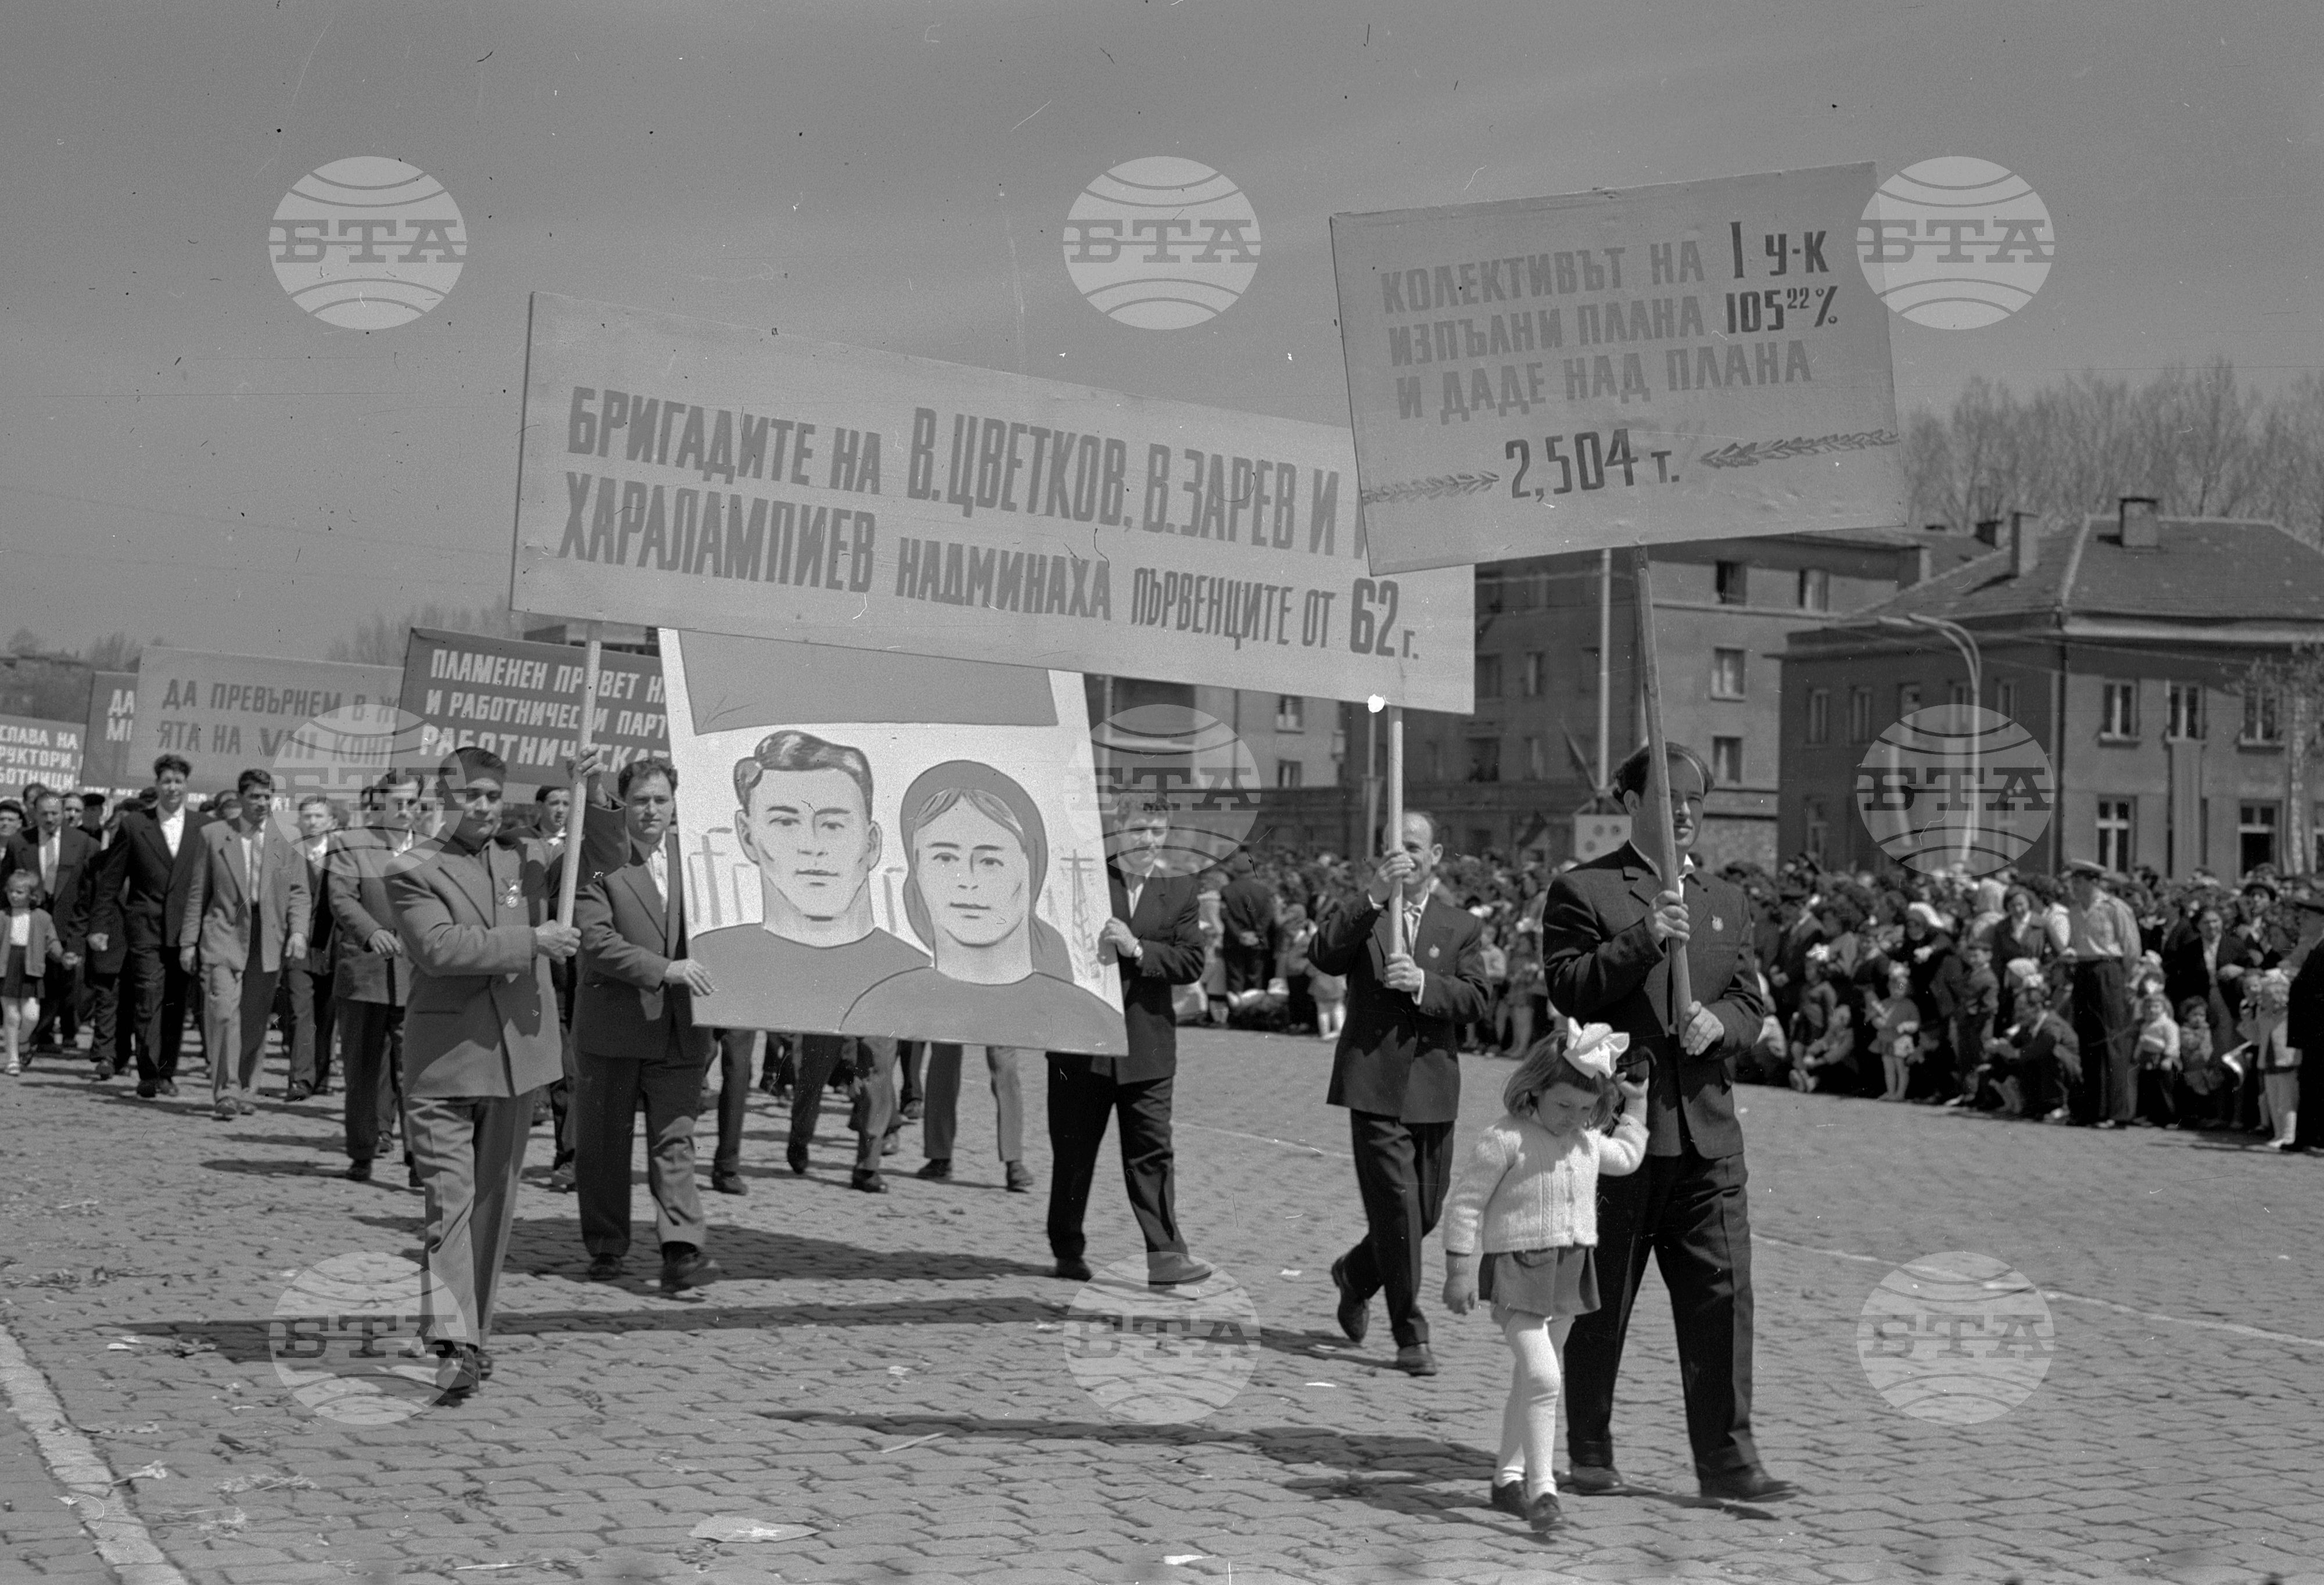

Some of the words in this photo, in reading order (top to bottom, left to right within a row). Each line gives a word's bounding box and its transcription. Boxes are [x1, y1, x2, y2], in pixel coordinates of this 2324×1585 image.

[1380, 247, 1625, 314] КОЛЕКТИВЪТ
[1649, 241, 1705, 285] НА
[1389, 308, 1563, 367] ИЗПЪЛНИ
[1577, 295, 1705, 346] ПЛАНА
[1396, 376, 1423, 420] И
[1440, 361, 1546, 426] ДАДЕ
[1563, 353, 1651, 404] НАД
[1666, 340, 1812, 392] ПЛАНА
[567, 385, 816, 486] БРИГАДИТЕ
[829, 426, 882, 496] НА
[1308, 468, 1340, 557] И
[1505, 428, 1639, 503] 2,504
[558, 471, 876, 593] ХАРАЛАМПИЕВ
[895, 537, 1112, 621] НАДМИНАХА
[1131, 567, 1294, 651] ПЪРВЕНЦИТЕ
[1301, 588, 1336, 648] ОТ
[162, 677, 198, 711] ДА
[210, 682, 342, 720] ПРЕВЪРНЕМ
[351, 694, 367, 722] В
[431, 648, 549, 691] ПЛАМЕНЕН
[554, 665, 641, 700] ПРВЕТ
[56, 731, 79, 750] НА
[157, 720, 200, 752] ЯТА
[212, 723, 242, 755] НА
[425, 688, 443, 716] И
[448, 691, 609, 733] РАБОТНИЧЕСИ
